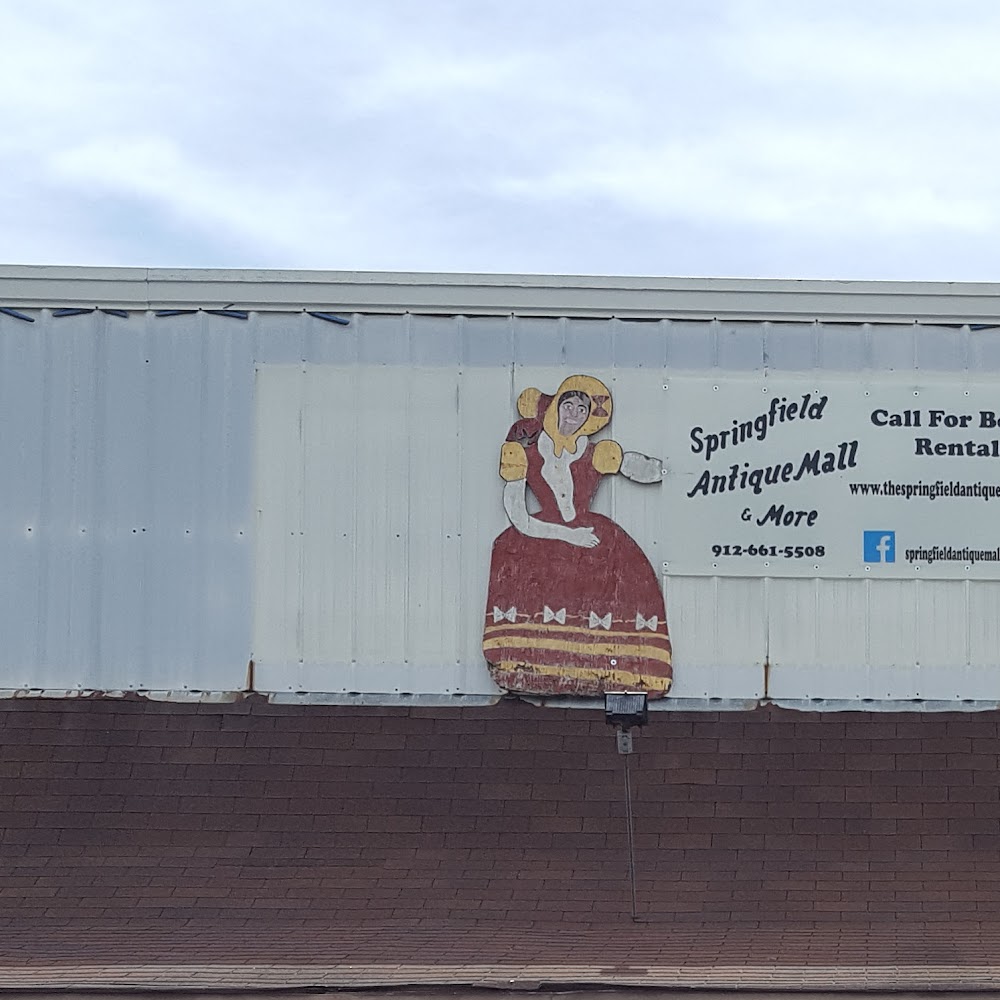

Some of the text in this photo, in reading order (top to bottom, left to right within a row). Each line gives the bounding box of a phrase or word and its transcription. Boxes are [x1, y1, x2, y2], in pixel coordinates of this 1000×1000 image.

[690, 393, 828, 461] Springfield
[870, 409, 922, 428] Call
[928, 410, 973, 429] For
[741, 504, 819, 527] & More
[711, 544, 826, 559] 912-661-5508
